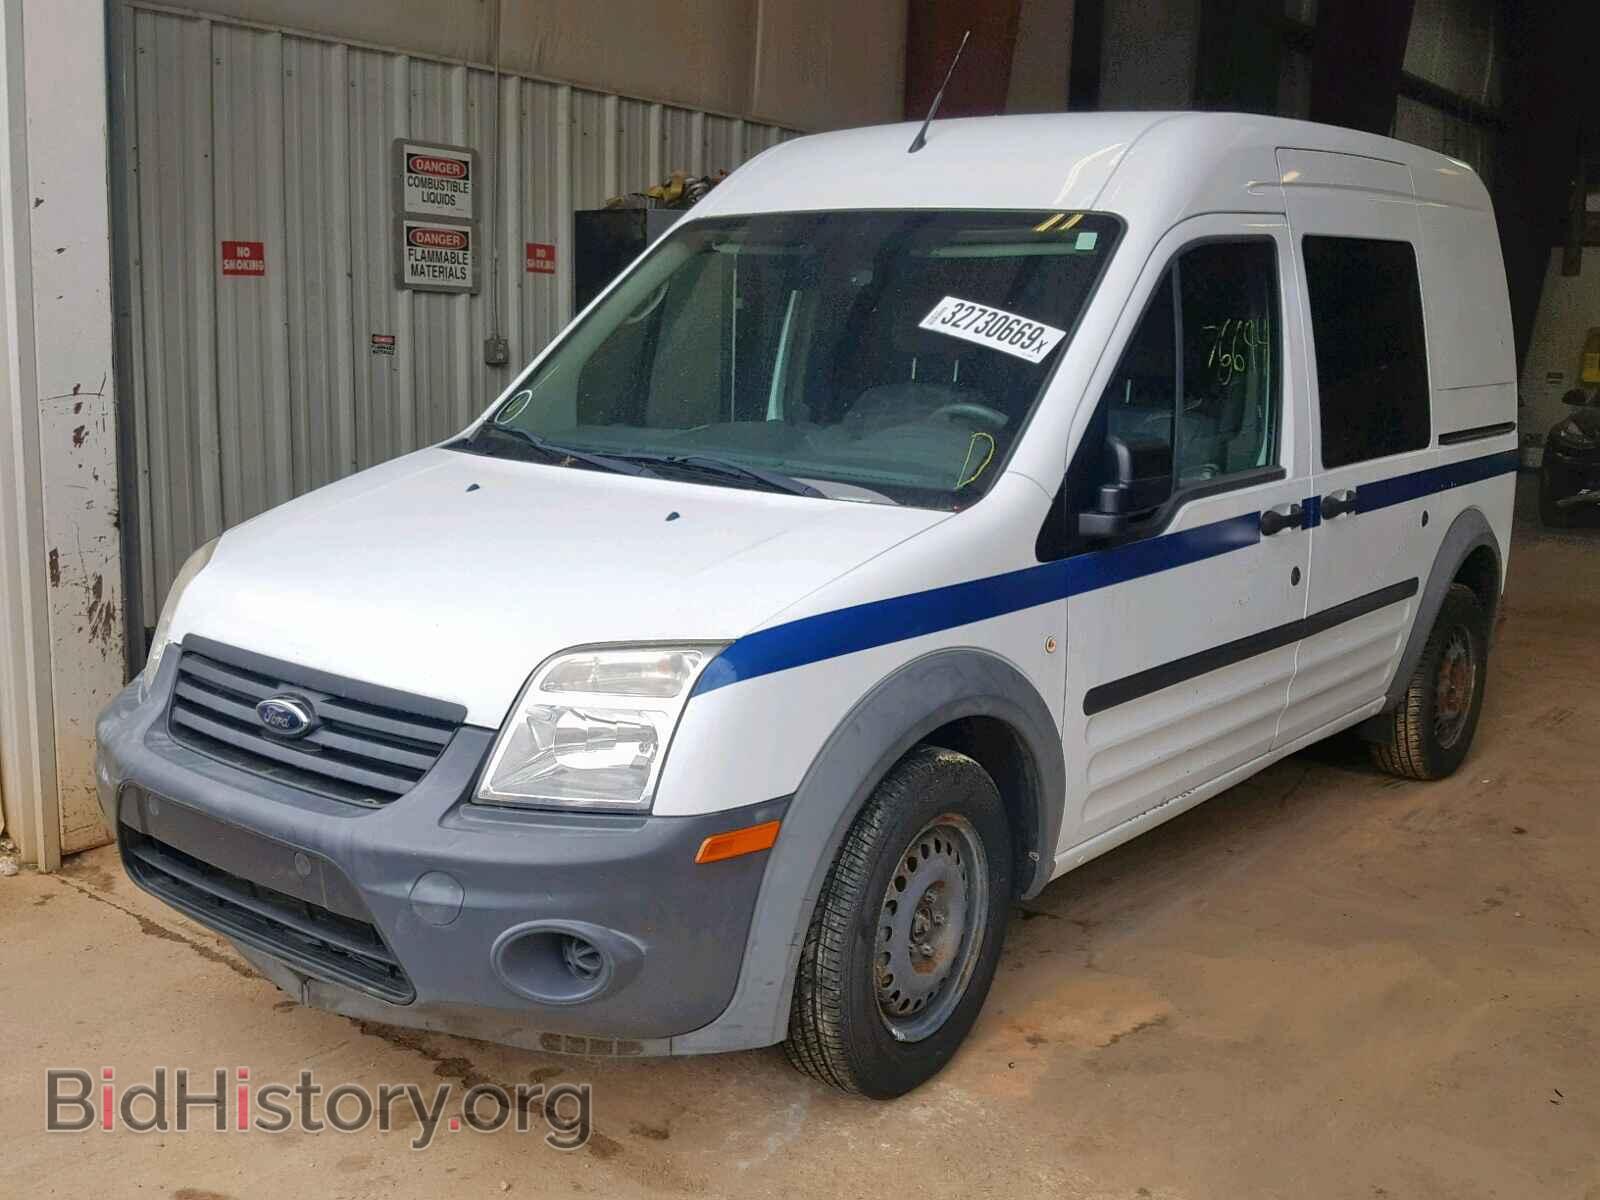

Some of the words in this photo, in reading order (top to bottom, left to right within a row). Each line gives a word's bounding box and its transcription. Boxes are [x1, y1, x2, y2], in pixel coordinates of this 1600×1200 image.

[415, 159, 461, 175] DANGER
[407, 175, 469, 194] COMBUSTIBLE
[421, 190, 456, 207] LIQUIDS
[415, 231, 461, 246] DANGER
[236, 246, 250, 258] NO
[408, 247, 469, 266] FLAMMABLE
[410, 263, 467, 280] MATERIALS
[940, 302, 1045, 350] 32730669
